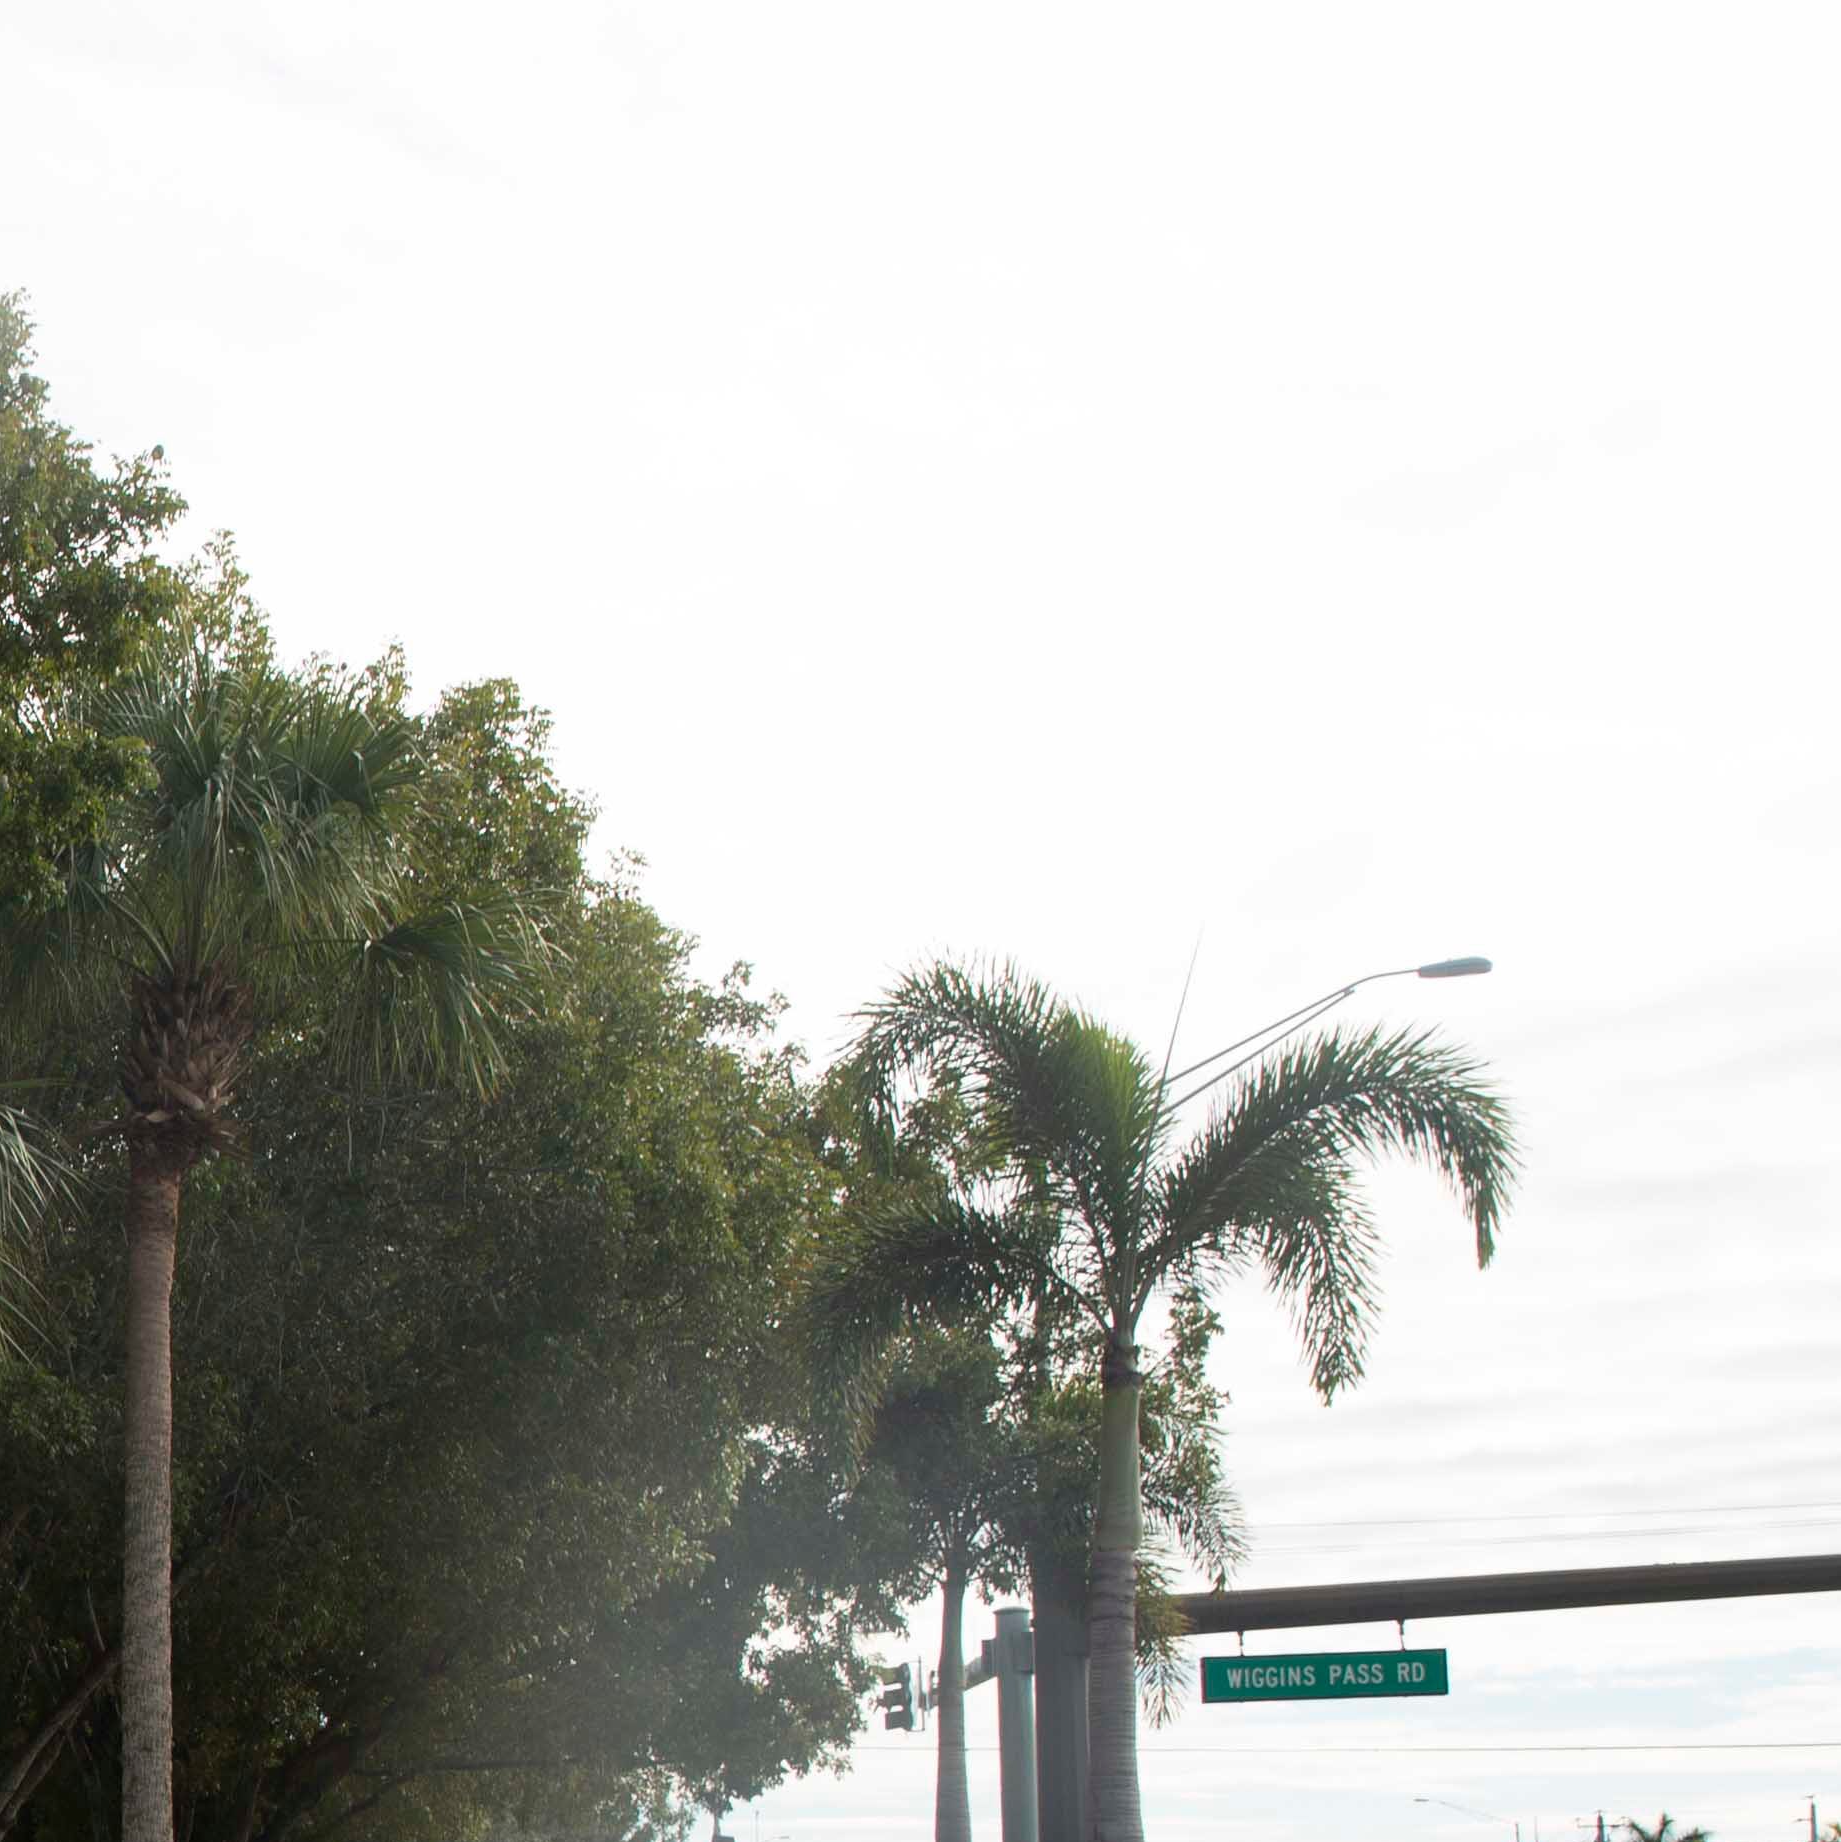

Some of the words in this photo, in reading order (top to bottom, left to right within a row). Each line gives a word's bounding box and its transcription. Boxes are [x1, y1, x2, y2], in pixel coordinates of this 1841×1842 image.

[1226, 1665, 1316, 1689] WIGGINS
[1329, 1663, 1384, 1685] PASS
[1397, 1661, 1426, 1683] RD
